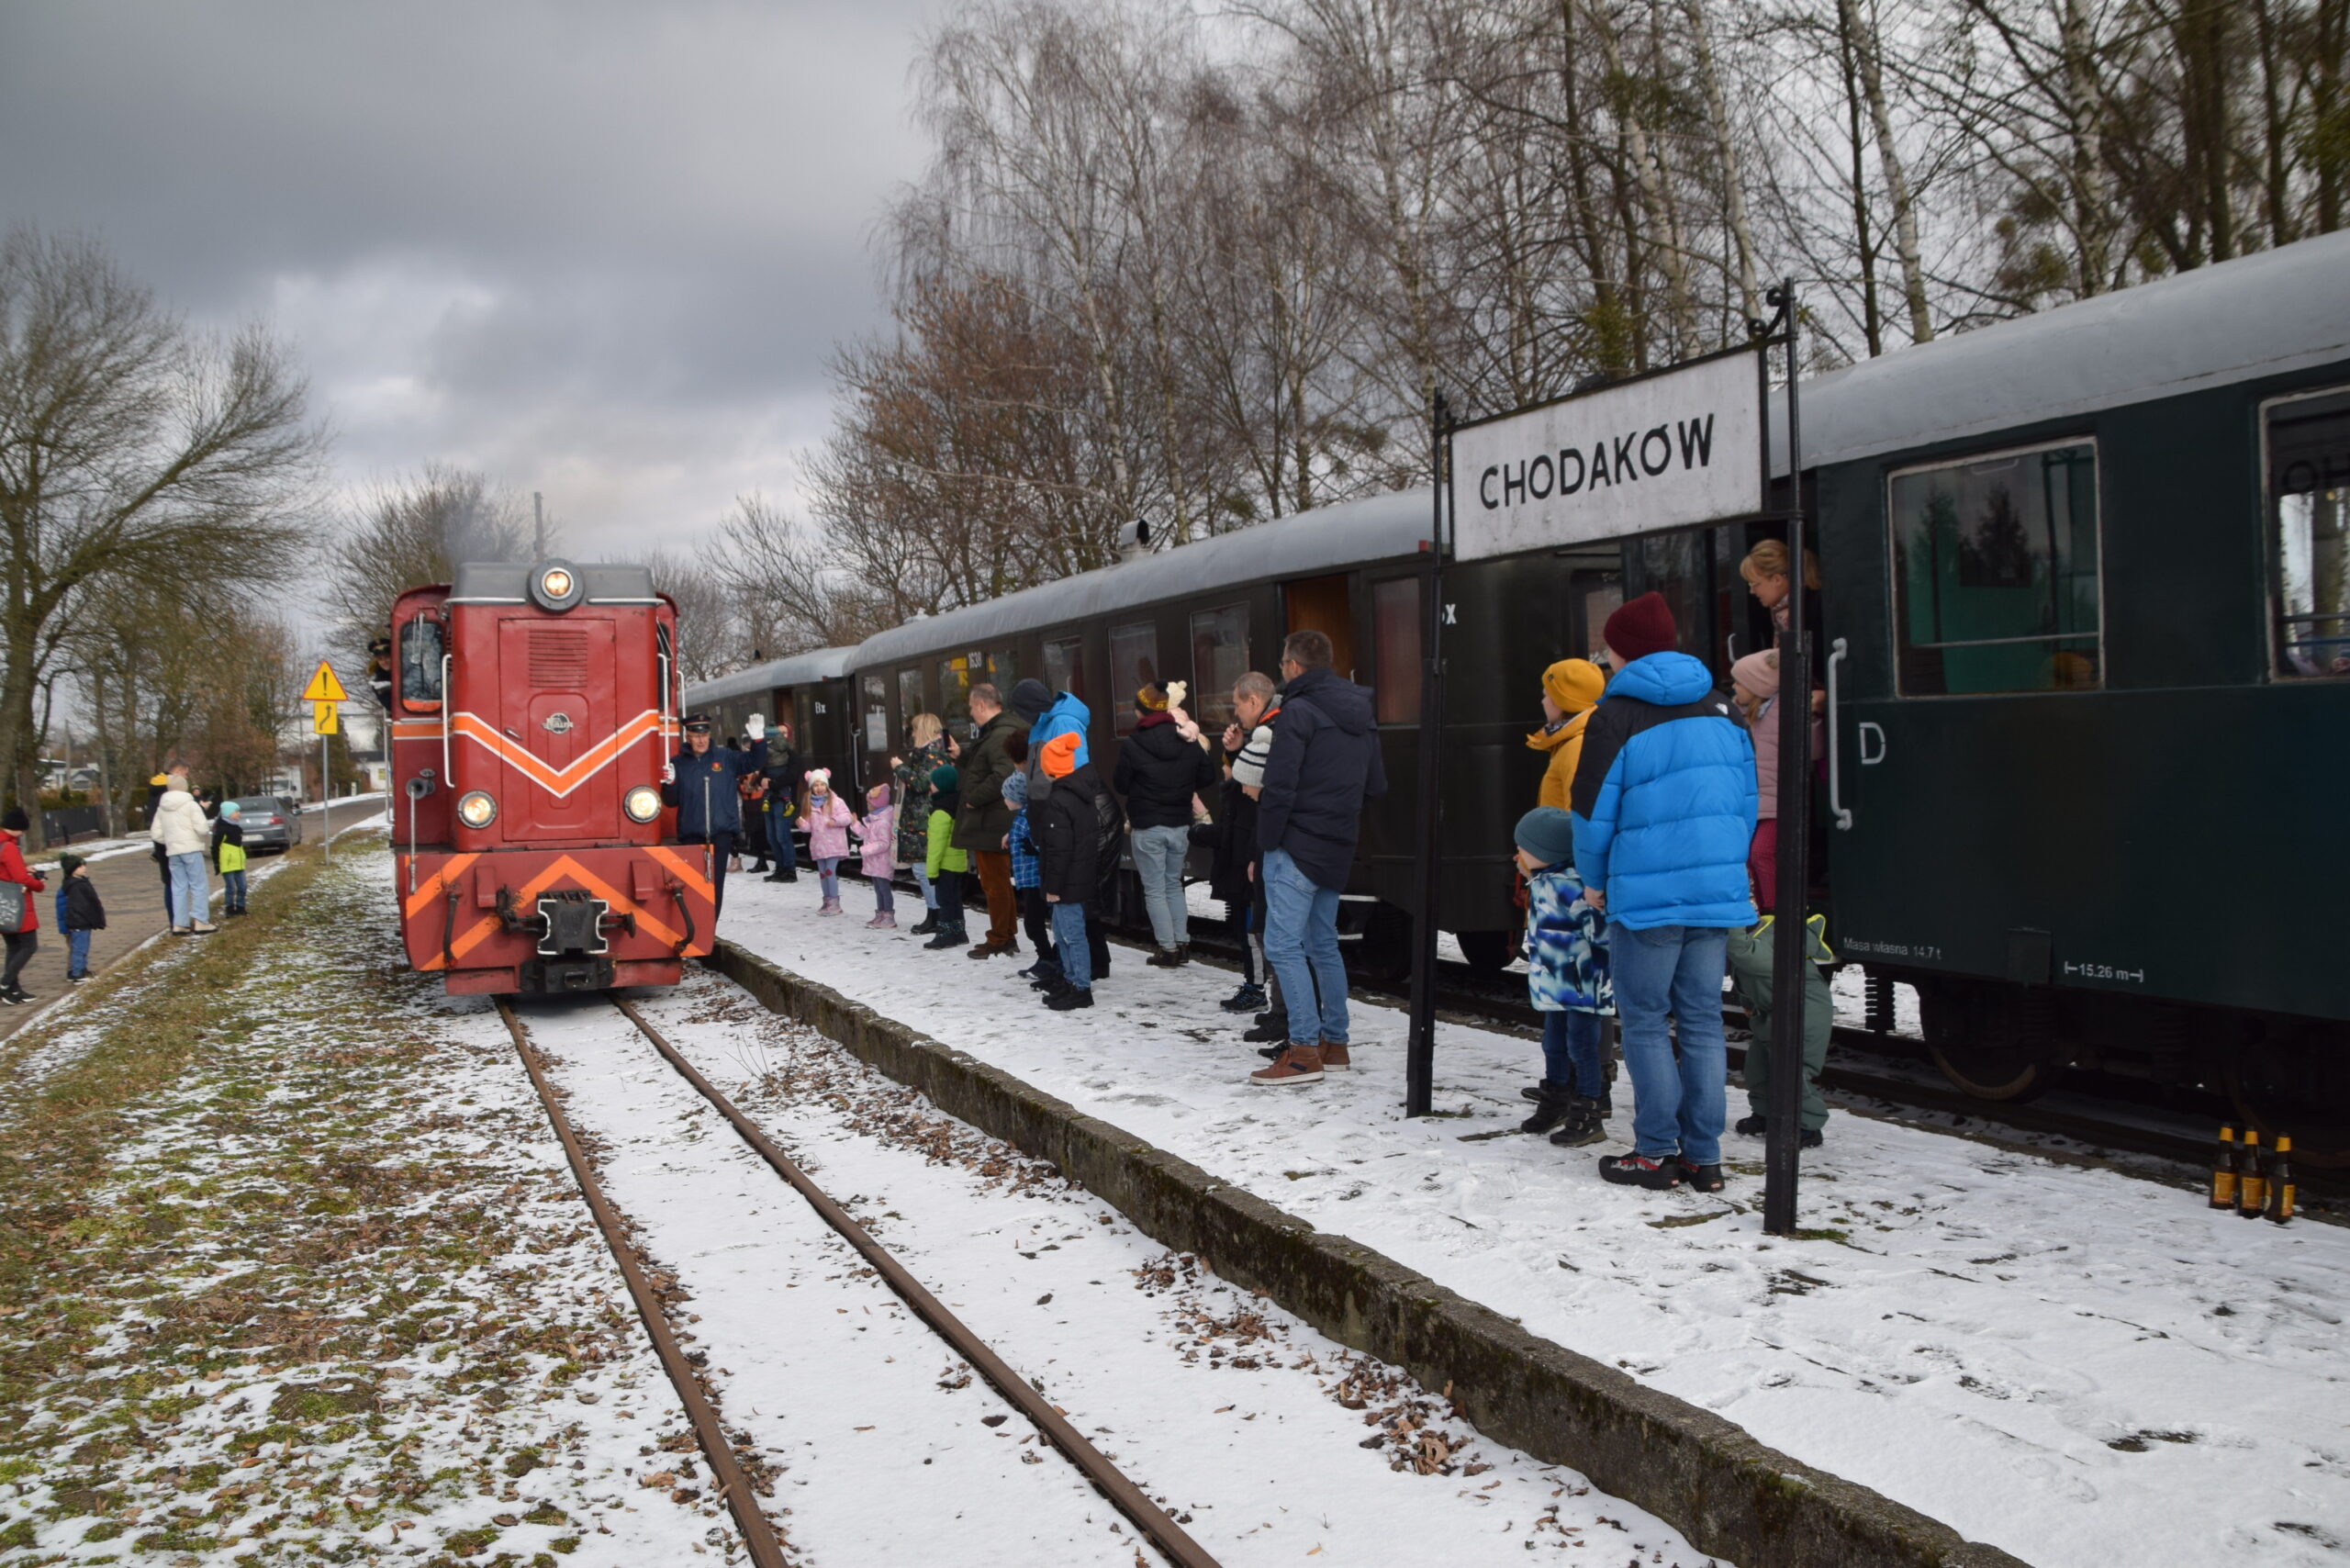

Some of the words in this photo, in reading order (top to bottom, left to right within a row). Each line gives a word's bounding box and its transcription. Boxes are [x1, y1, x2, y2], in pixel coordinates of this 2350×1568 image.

[1480, 413, 1715, 510] CHODAKÓW
[1859, 722, 1886, 765] D
[1843, 936, 1870, 952] Masa
[1913, 946, 1935, 959] 14.7
[1937, 947, 1942, 960] t
[2079, 962, 2112, 979] 15.26
[2116, 969, 2130, 980] m
